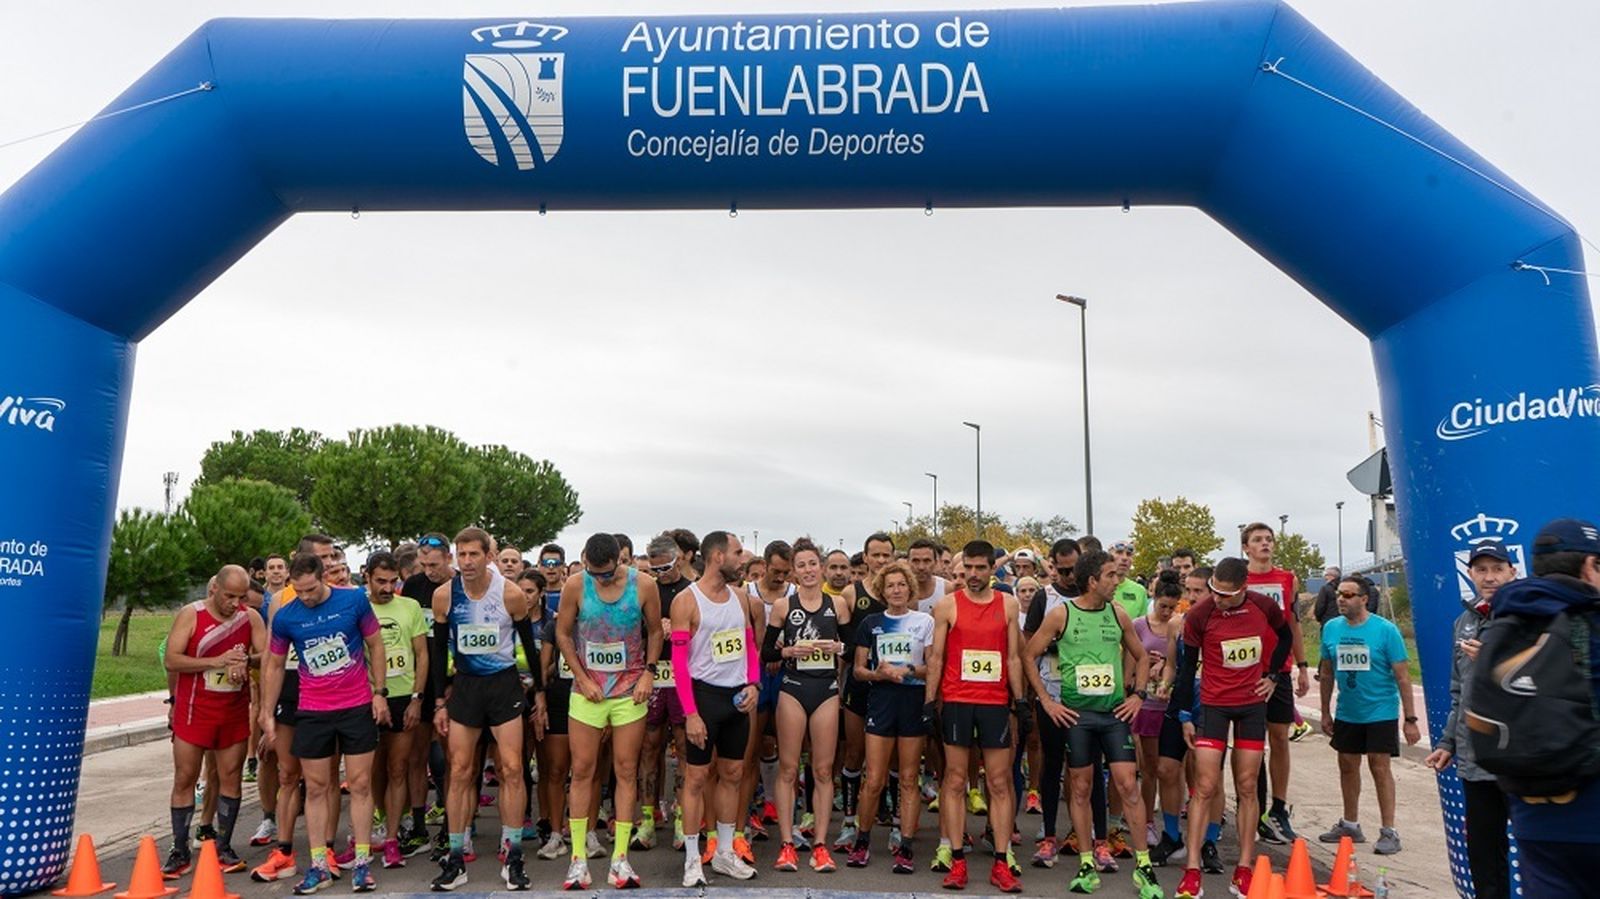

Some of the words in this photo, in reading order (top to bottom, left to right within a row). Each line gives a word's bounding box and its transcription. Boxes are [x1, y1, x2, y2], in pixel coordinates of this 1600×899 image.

[621, 19, 920, 63] Ayuntamiento
[935, 16, 990, 49] de
[622, 62, 990, 118] FUENLABRADA
[627, 129, 760, 162] Concejalía
[768, 128, 799, 156] de
[808, 128, 925, 160] Deportes
[29, 540, 48, 557] de
[461, 634, 497, 647] 1380
[715, 637, 742, 655] 153
[880, 642, 911, 655] 1144
[309, 647, 346, 668] 1382
[587, 651, 623, 665] 1009
[1228, 646, 1256, 662] 401
[1340, 653, 1367, 665] 1010
[971, 659, 993, 674] 94
[1081, 674, 1112, 688] 332
